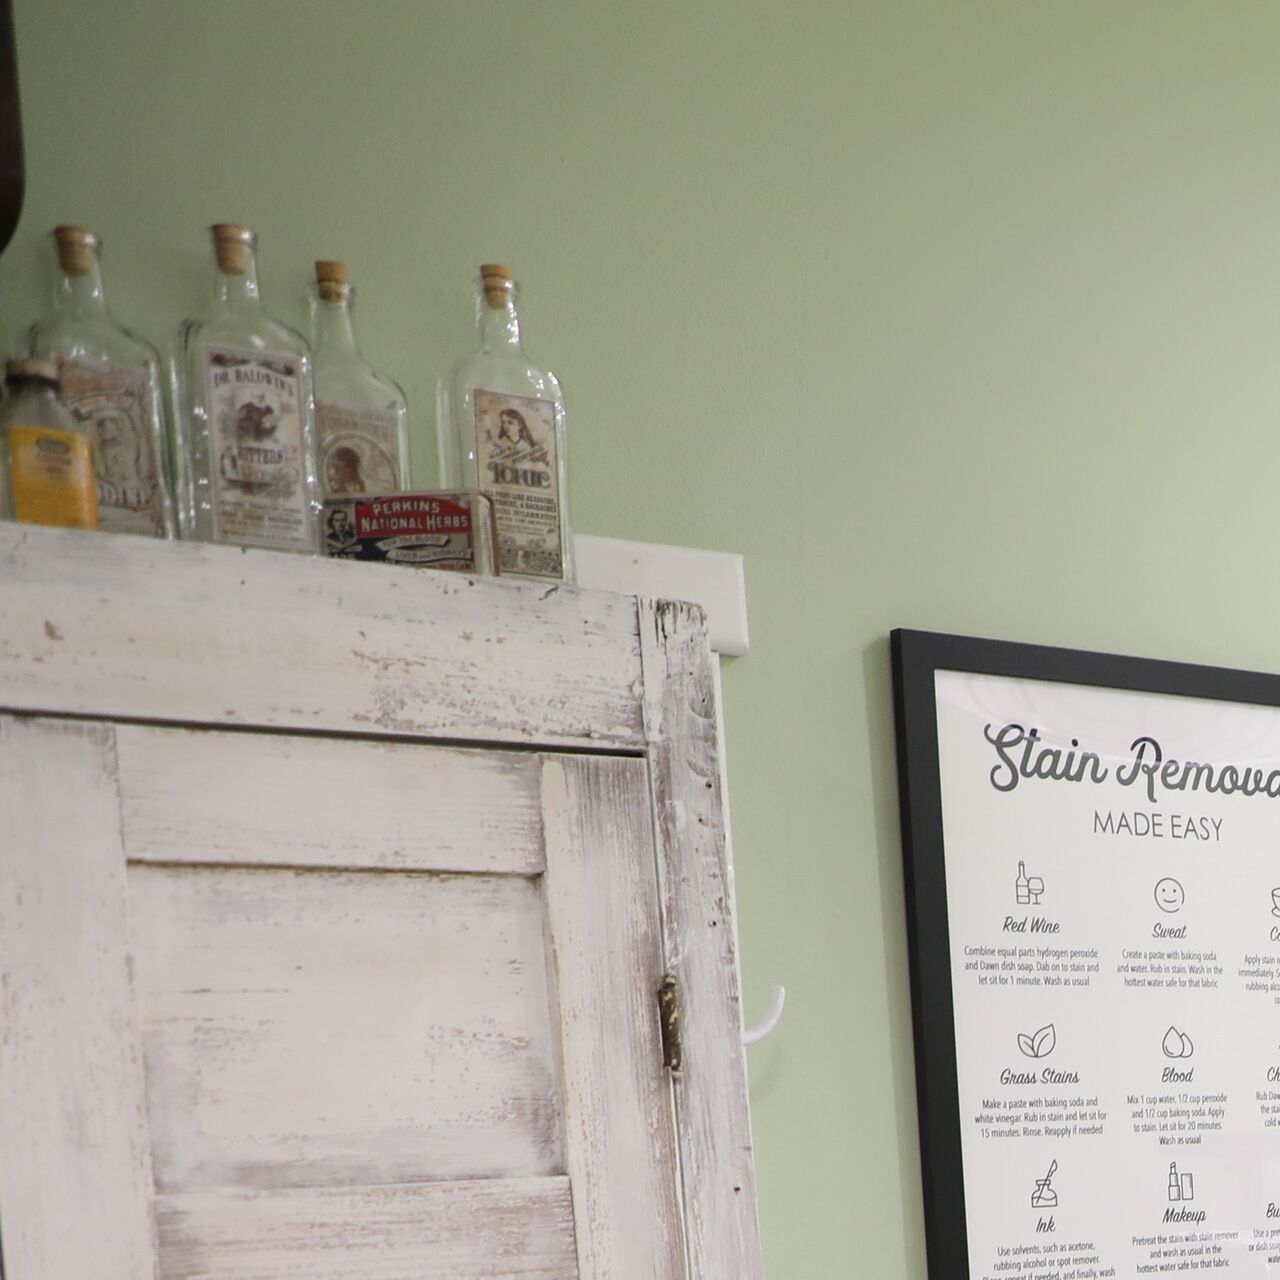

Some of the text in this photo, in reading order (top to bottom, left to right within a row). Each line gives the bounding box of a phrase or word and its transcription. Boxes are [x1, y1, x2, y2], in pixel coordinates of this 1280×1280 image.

[372, 501, 440, 516] PERKINS
[361, 516, 468, 532] NATIONAL HERBS
[984, 722, 1108, 793] Stain
[1093, 811, 1224, 842] MADE EASY
[1002, 916, 1060, 934] Red Wine
[1152, 922, 1187, 939] Sweat
[964, 946, 1098, 960] Combine equal parts hydrogen peroxide
[965, 961, 978, 970] and
[980, 961, 999, 970] Dawn
[1001, 962, 1015, 971] dish
[1037, 962, 1049, 972] Dab
[1061, 964, 1068, 972] to
[1070, 963, 1085, 972] stain
[1087, 963, 1099, 972] and
[979, 976, 1089, 986] let sit for 1 minute. Wash as usual
[1000, 1068, 1080, 1085] Grass Stains
[1161, 1067, 1194, 1083] Blood
[982, 1099, 1001, 1109] Make
[1009, 1100, 1026, 1111] paste
[1029, 1098, 1043, 1108] with
[1045, 1098, 1067, 1110] baking
[1069, 1098, 1084, 1106] soda
[1086, 1097, 1098, 1106] and
[974, 1114, 993, 1123] white
[1024, 1112, 1038, 1122] Rub
[1040, 1113, 1046, 1121] in
[1048, 1112, 1063, 1121] stain
[1065, 1112, 1077, 1120] and
[1079, 1111, 1087, 1120] let
[1098, 1110, 1106, 1120] for
[981, 1125, 1103, 1138] 15 minutes. Rinse. Reapply if needed
[1162, 1207, 1206, 1225] Makeup
[1036, 1216, 1056, 1233] Ink
[998, 1247, 1010, 1256] Use
[1012, 1245, 1041, 1256] solvents,
[1043, 1243, 1058, 1254] such
[1069, 1242, 1095, 1252] acetone,
